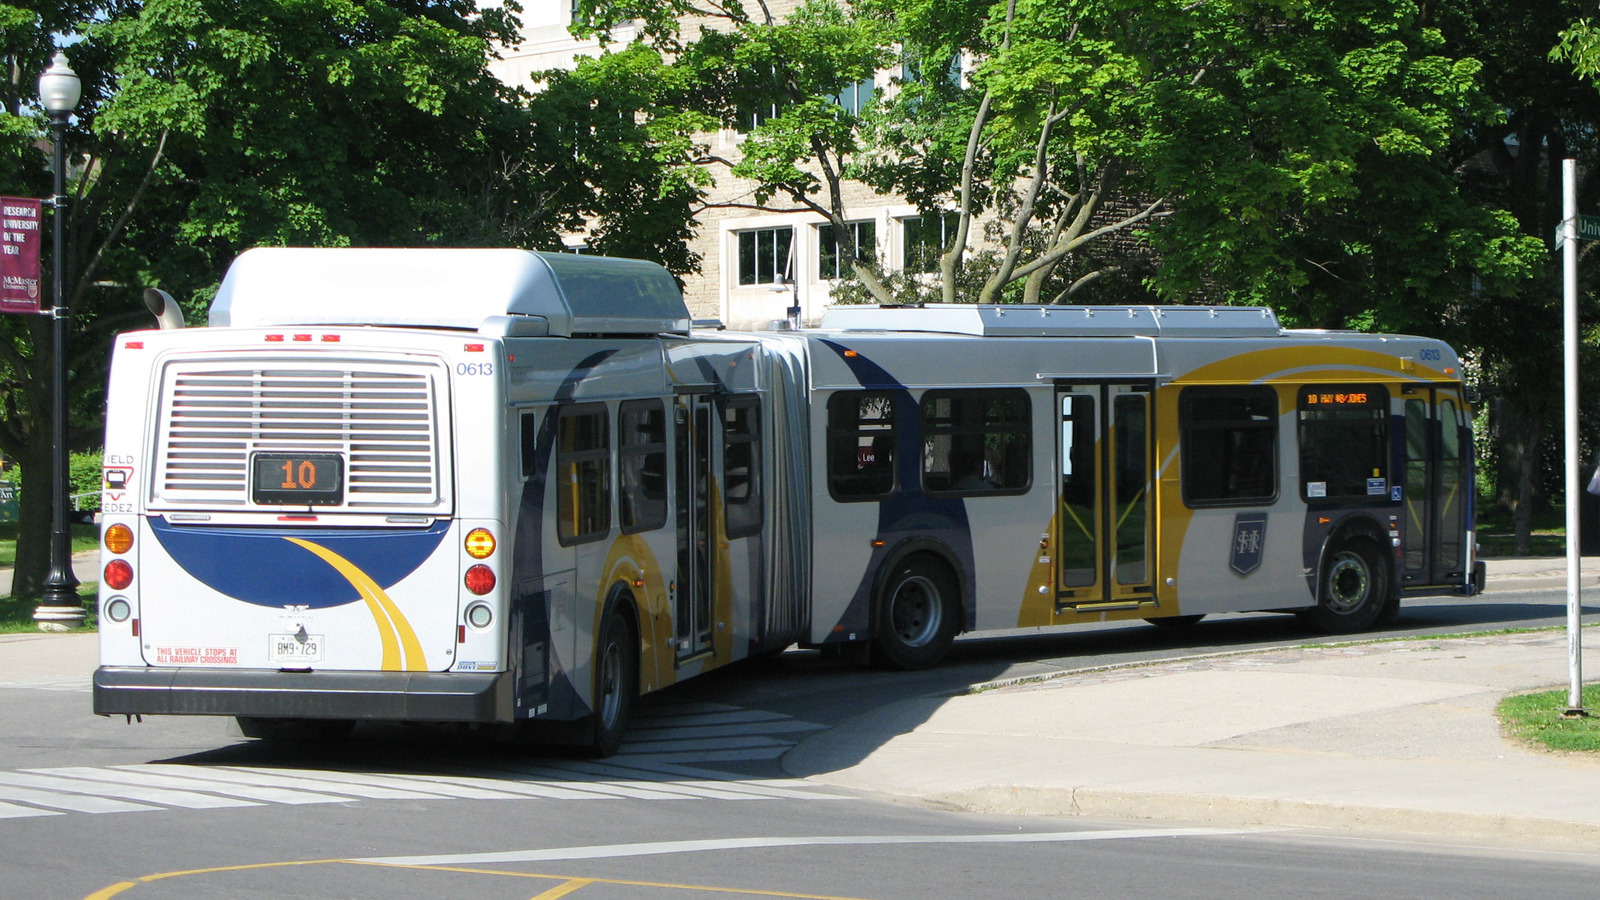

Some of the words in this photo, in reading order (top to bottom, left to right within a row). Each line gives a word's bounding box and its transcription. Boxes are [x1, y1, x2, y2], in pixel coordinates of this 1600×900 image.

[3, 206, 36, 217] RESEARCH
[3, 219, 39, 230] UNIVERSITY
[3, 232, 12, 242] OF
[13, 232, 26, 243] THE
[3, 244, 20, 255] YEAR
[3, 276, 38, 285] McMaster
[1420, 349, 1441, 360] 0613
[456, 362, 493, 376] 0613
[103, 454, 134, 465] IELD
[862, 453, 875, 462] Lee
[281, 460, 316, 489] 10
[101, 502, 134, 513] ÉDEZ
[156, 647, 173, 656] THIS
[174, 647, 202, 657] VEHICLE
[204, 647, 227, 657] STOPS
[229, 648, 238, 657] AT
[156, 655, 169, 664] ALL
[169, 655, 200, 665] RAILWAY
[199, 655, 238, 665] CROSSINGS
